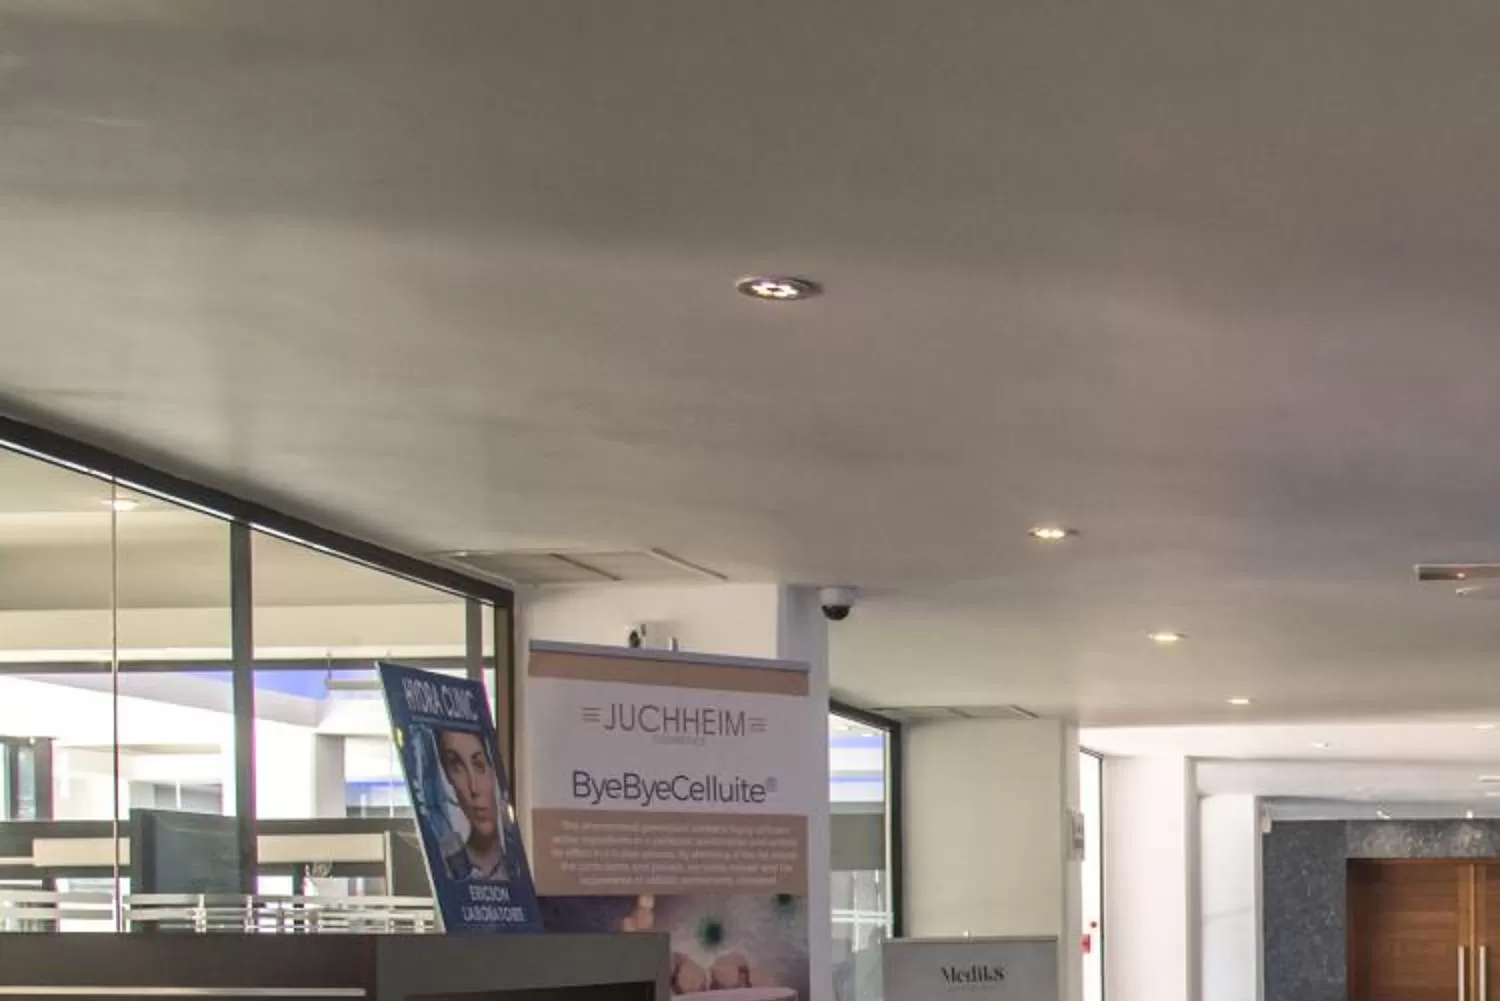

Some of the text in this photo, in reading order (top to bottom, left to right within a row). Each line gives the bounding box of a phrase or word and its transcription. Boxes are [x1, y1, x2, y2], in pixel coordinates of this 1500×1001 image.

[402, 677, 479, 721] HYDRA CLINIC
[603, 703, 746, 737] JUCHHEIM
[468, 884, 510, 902] ERICSON
